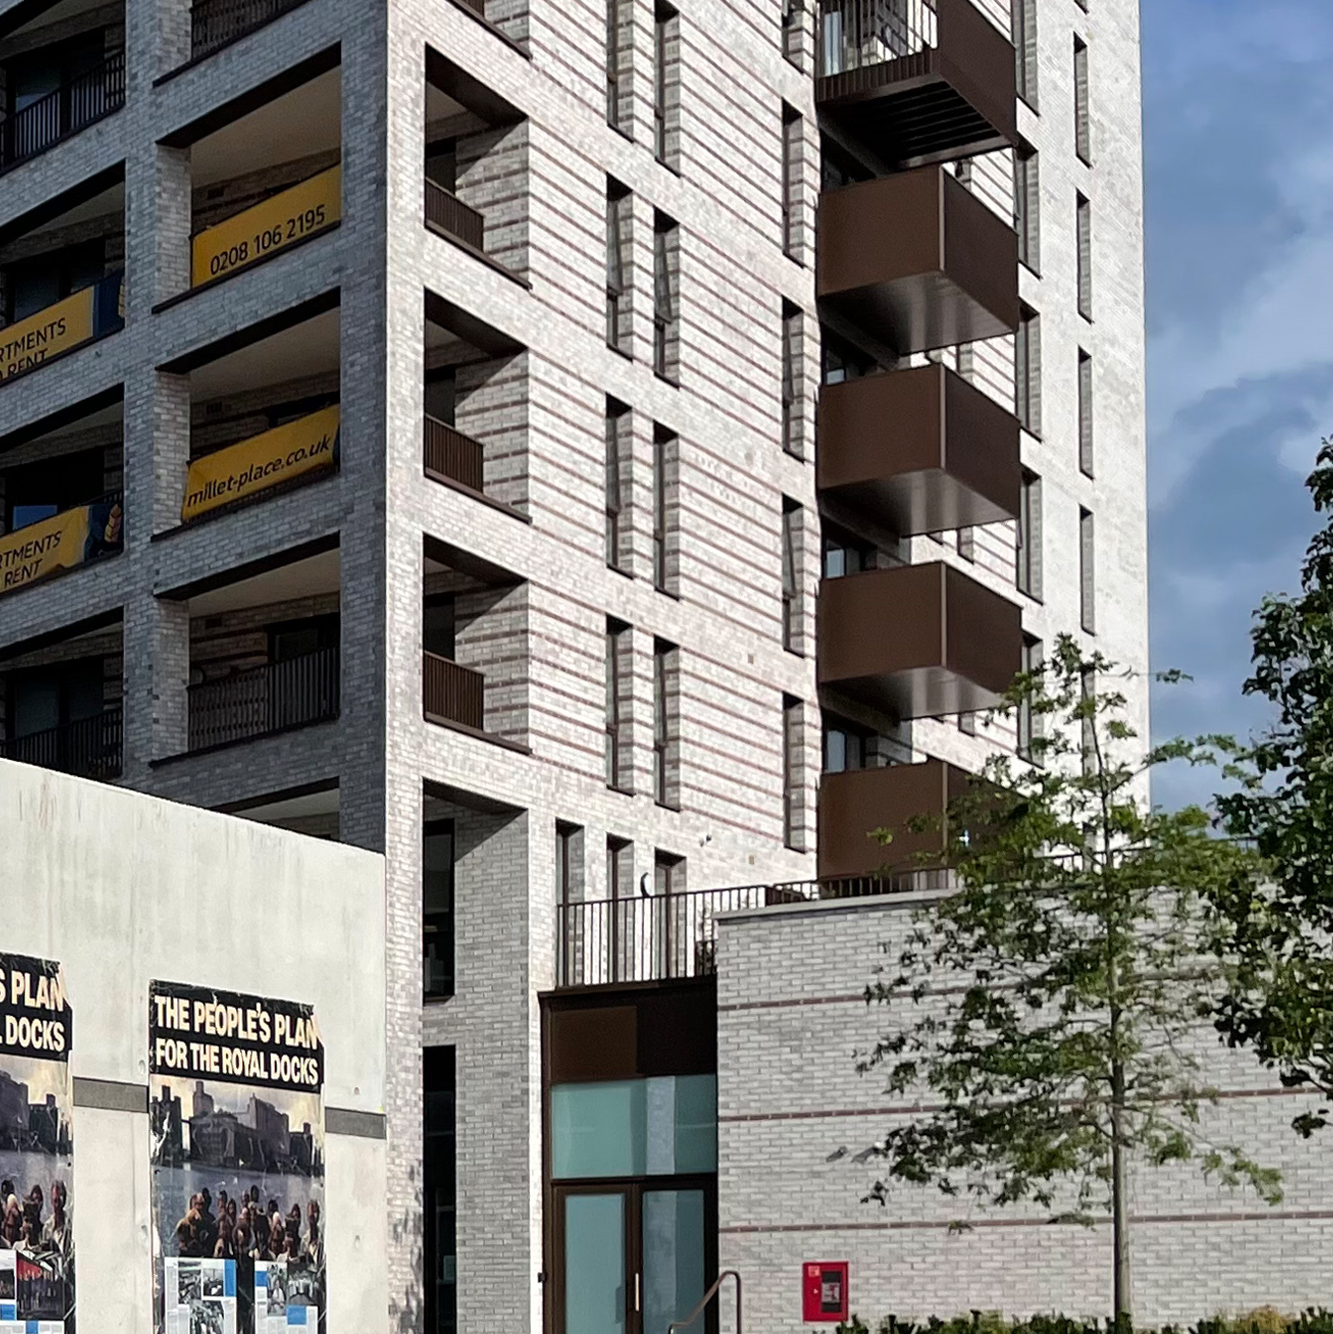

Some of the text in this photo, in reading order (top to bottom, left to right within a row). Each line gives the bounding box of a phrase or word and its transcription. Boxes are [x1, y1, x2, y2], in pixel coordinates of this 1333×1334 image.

[210, 204, 325, 276] 0208 106 2195
[187, 434, 331, 508] millet-place.co.uk
[5, 558, 43, 587] RENT
[11, 971, 64, 1012] PLAN
[5, 1016, 65, 1052] DOCKS
[154, 995, 318, 1050] THE PEOPLE'S PLAN
[156, 1037, 319, 1086] FOR THE ROYAL DOCKS
